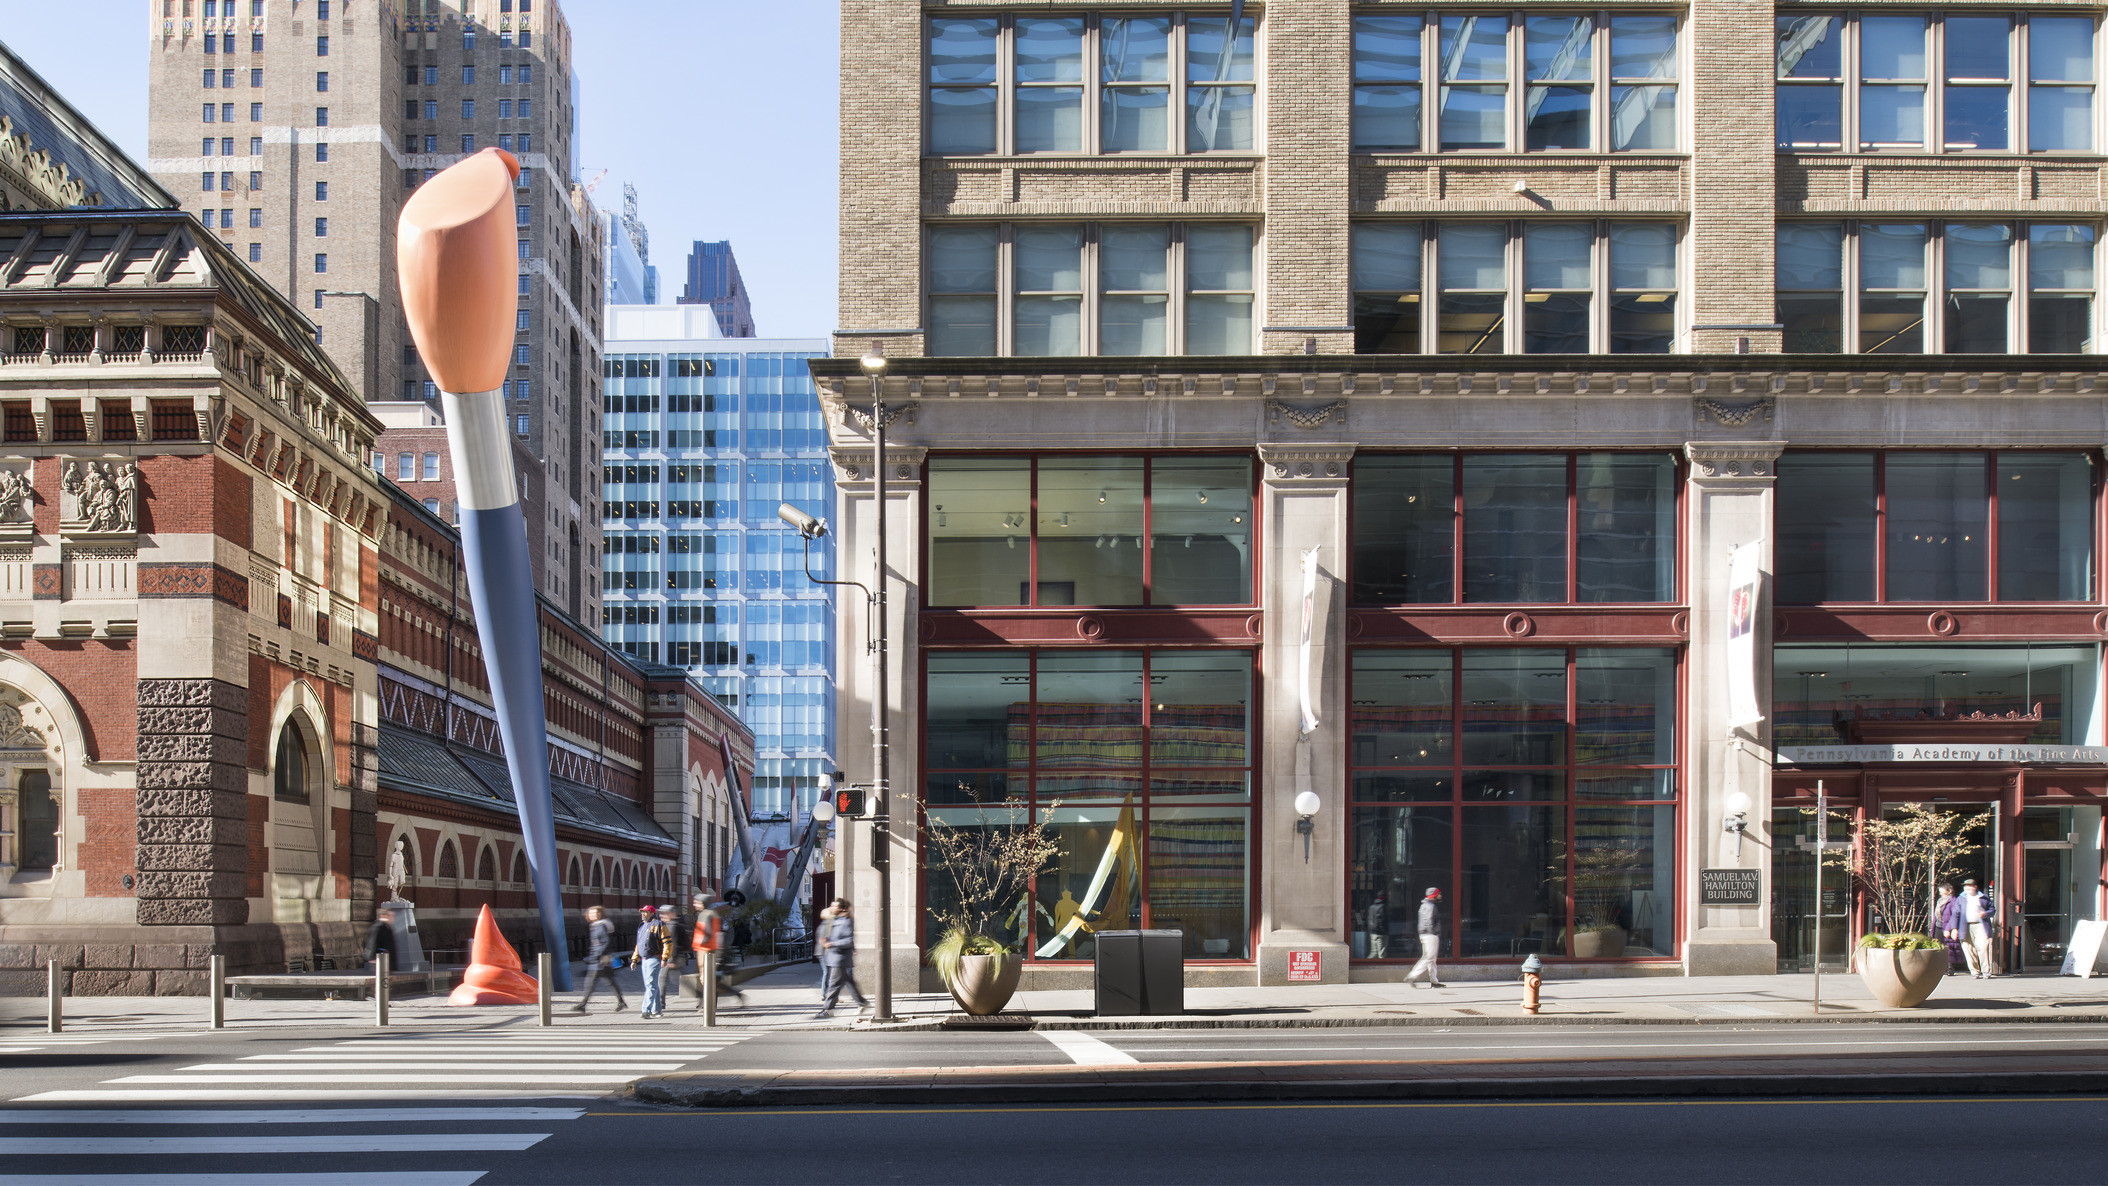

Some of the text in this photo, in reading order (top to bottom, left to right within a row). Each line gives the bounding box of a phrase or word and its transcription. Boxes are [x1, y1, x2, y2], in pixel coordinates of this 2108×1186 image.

[1797, 747, 2100, 761] Pennsylvania Academy of the Fine Arts
[1702, 872, 1740, 881] SAMUEL
[1705, 881, 1755, 890] HAMILTON
[1707, 890, 1753, 899] BUILDING
[1296, 952, 1313, 961] FDC
